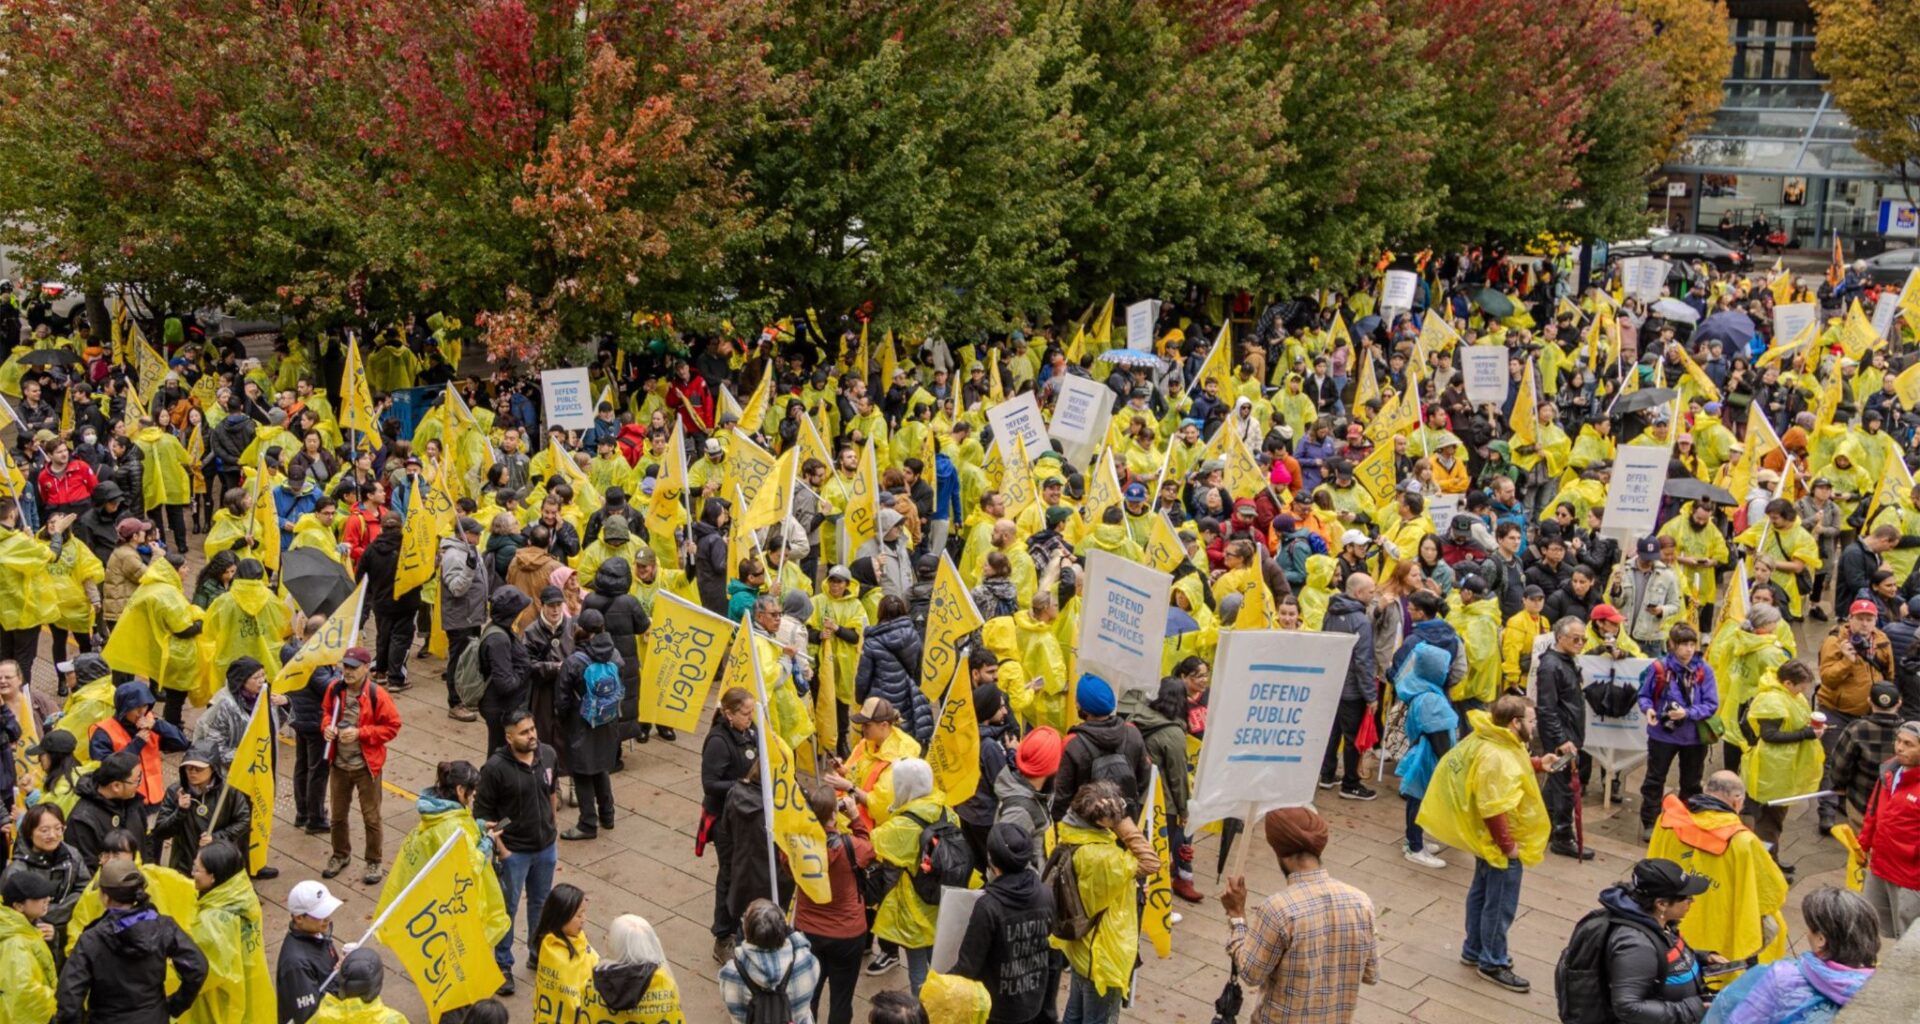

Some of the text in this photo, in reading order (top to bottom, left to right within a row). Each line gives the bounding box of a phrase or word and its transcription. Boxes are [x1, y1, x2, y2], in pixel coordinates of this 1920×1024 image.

[554, 387, 578, 396] DEFEND
[554, 403, 582, 412] SERVICES
[1067, 404, 1087, 416] PUBLIC
[1069, 396, 1090, 407] DEFEND
[1005, 415, 1030, 430] DEFEND
[1062, 410, 1087, 424] SERVICES
[1108, 591, 1144, 615] DEFEND
[1108, 606, 1141, 629] PUBLIC
[1101, 617, 1145, 645] SERVICES
[1249, 683, 1311, 703] DEFEND
[1246, 705, 1303, 725] PUBLIC
[1233, 727, 1306, 747] SERVICES
[1000, 971, 1043, 996] PLANET
[296, 993, 315, 1009] HH
